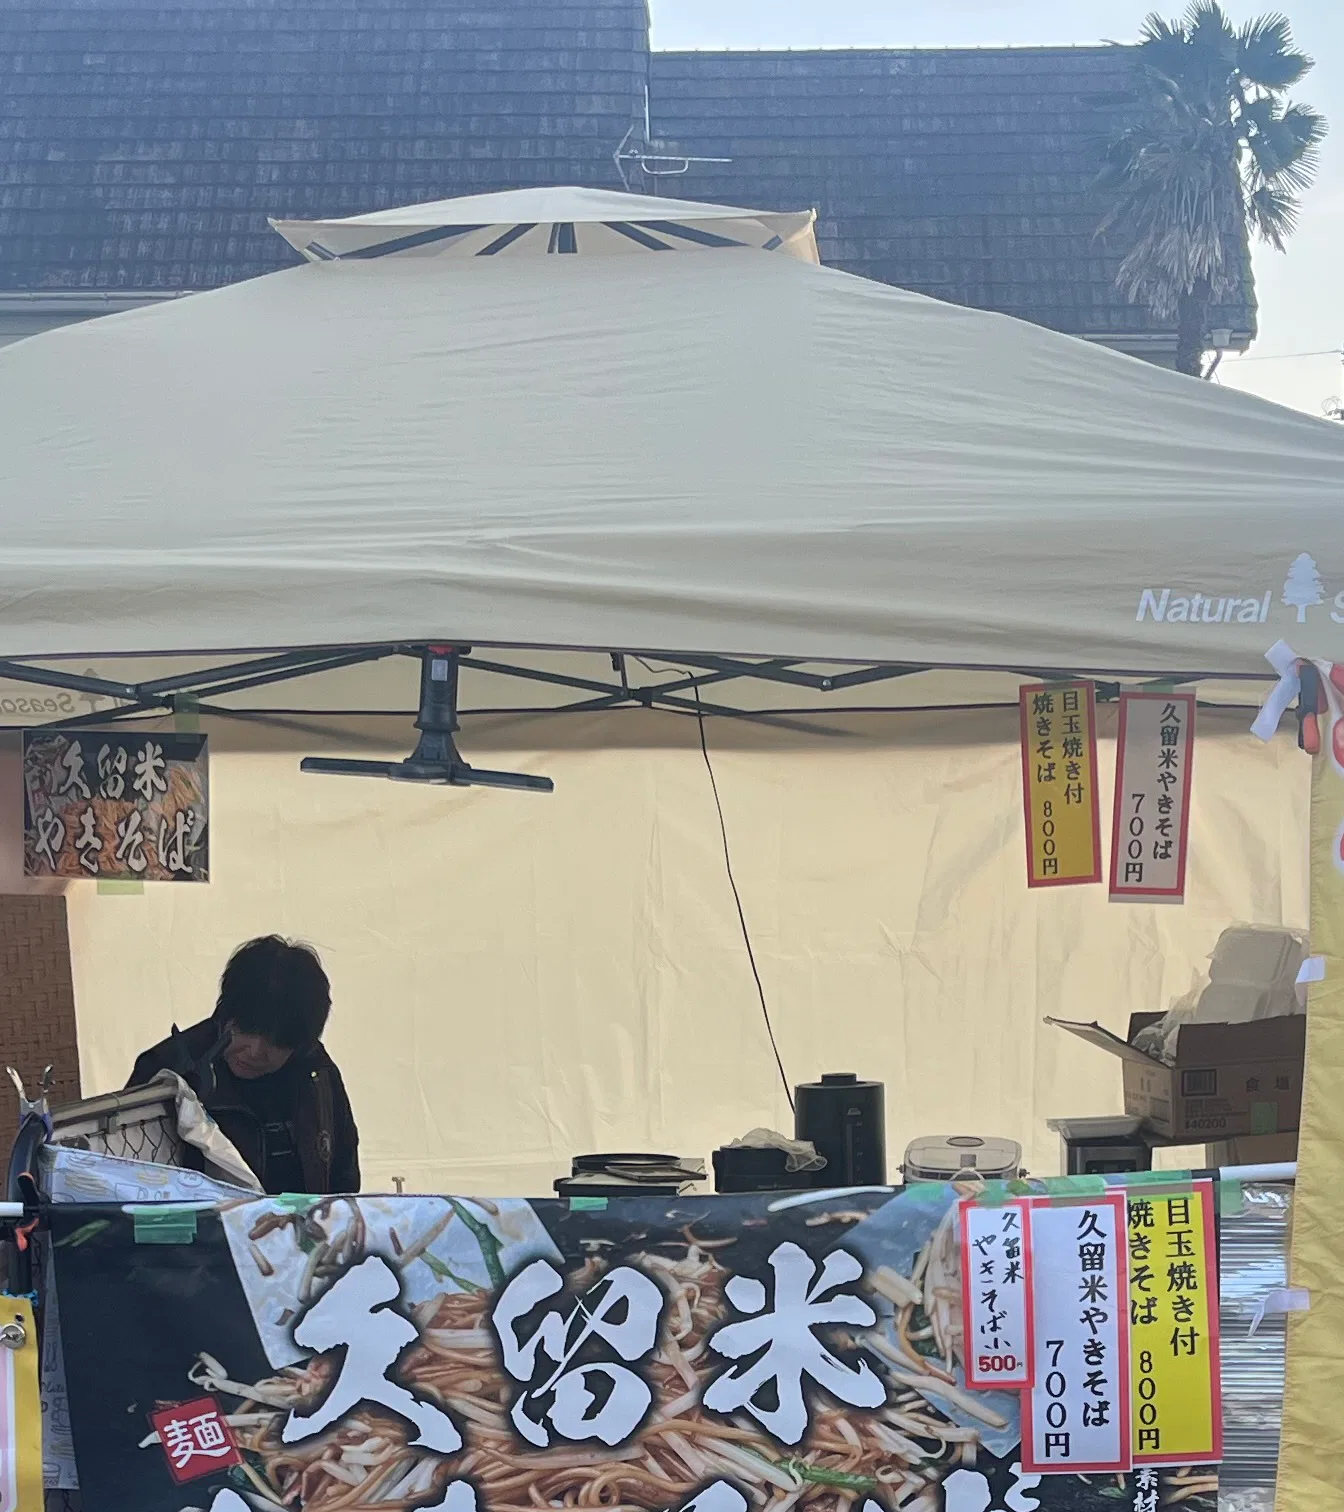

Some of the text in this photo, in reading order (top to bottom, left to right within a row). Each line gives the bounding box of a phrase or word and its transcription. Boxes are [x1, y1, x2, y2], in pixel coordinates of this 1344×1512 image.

[1136, 587, 1272, 623] Natural
[59, 740, 168, 801] 久留米
[1032, 692, 1058, 876] 焼きそば 800円
[1061, 690, 1085, 805] 目玉焼き付
[1152, 702, 1181, 861] 久留米やきそば
[34, 807, 194, 874] やきそば
[1124, 793, 1146, 883] 700円
[1001, 1211, 1025, 1284] 久留米
[1165, 1196, 1201, 1357] 目玉焼き付
[282, 1241, 886, 1454] 久留米
[978, 1355, 1023, 1373] 500円
[1076, 1209, 1110, 1428] 久留米やきそば
[1127, 1198, 1160, 1451] 焼きそば 800円
[163, 1412, 231, 1469] 麺
[1044, 1340, 1071, 1458] 700円
